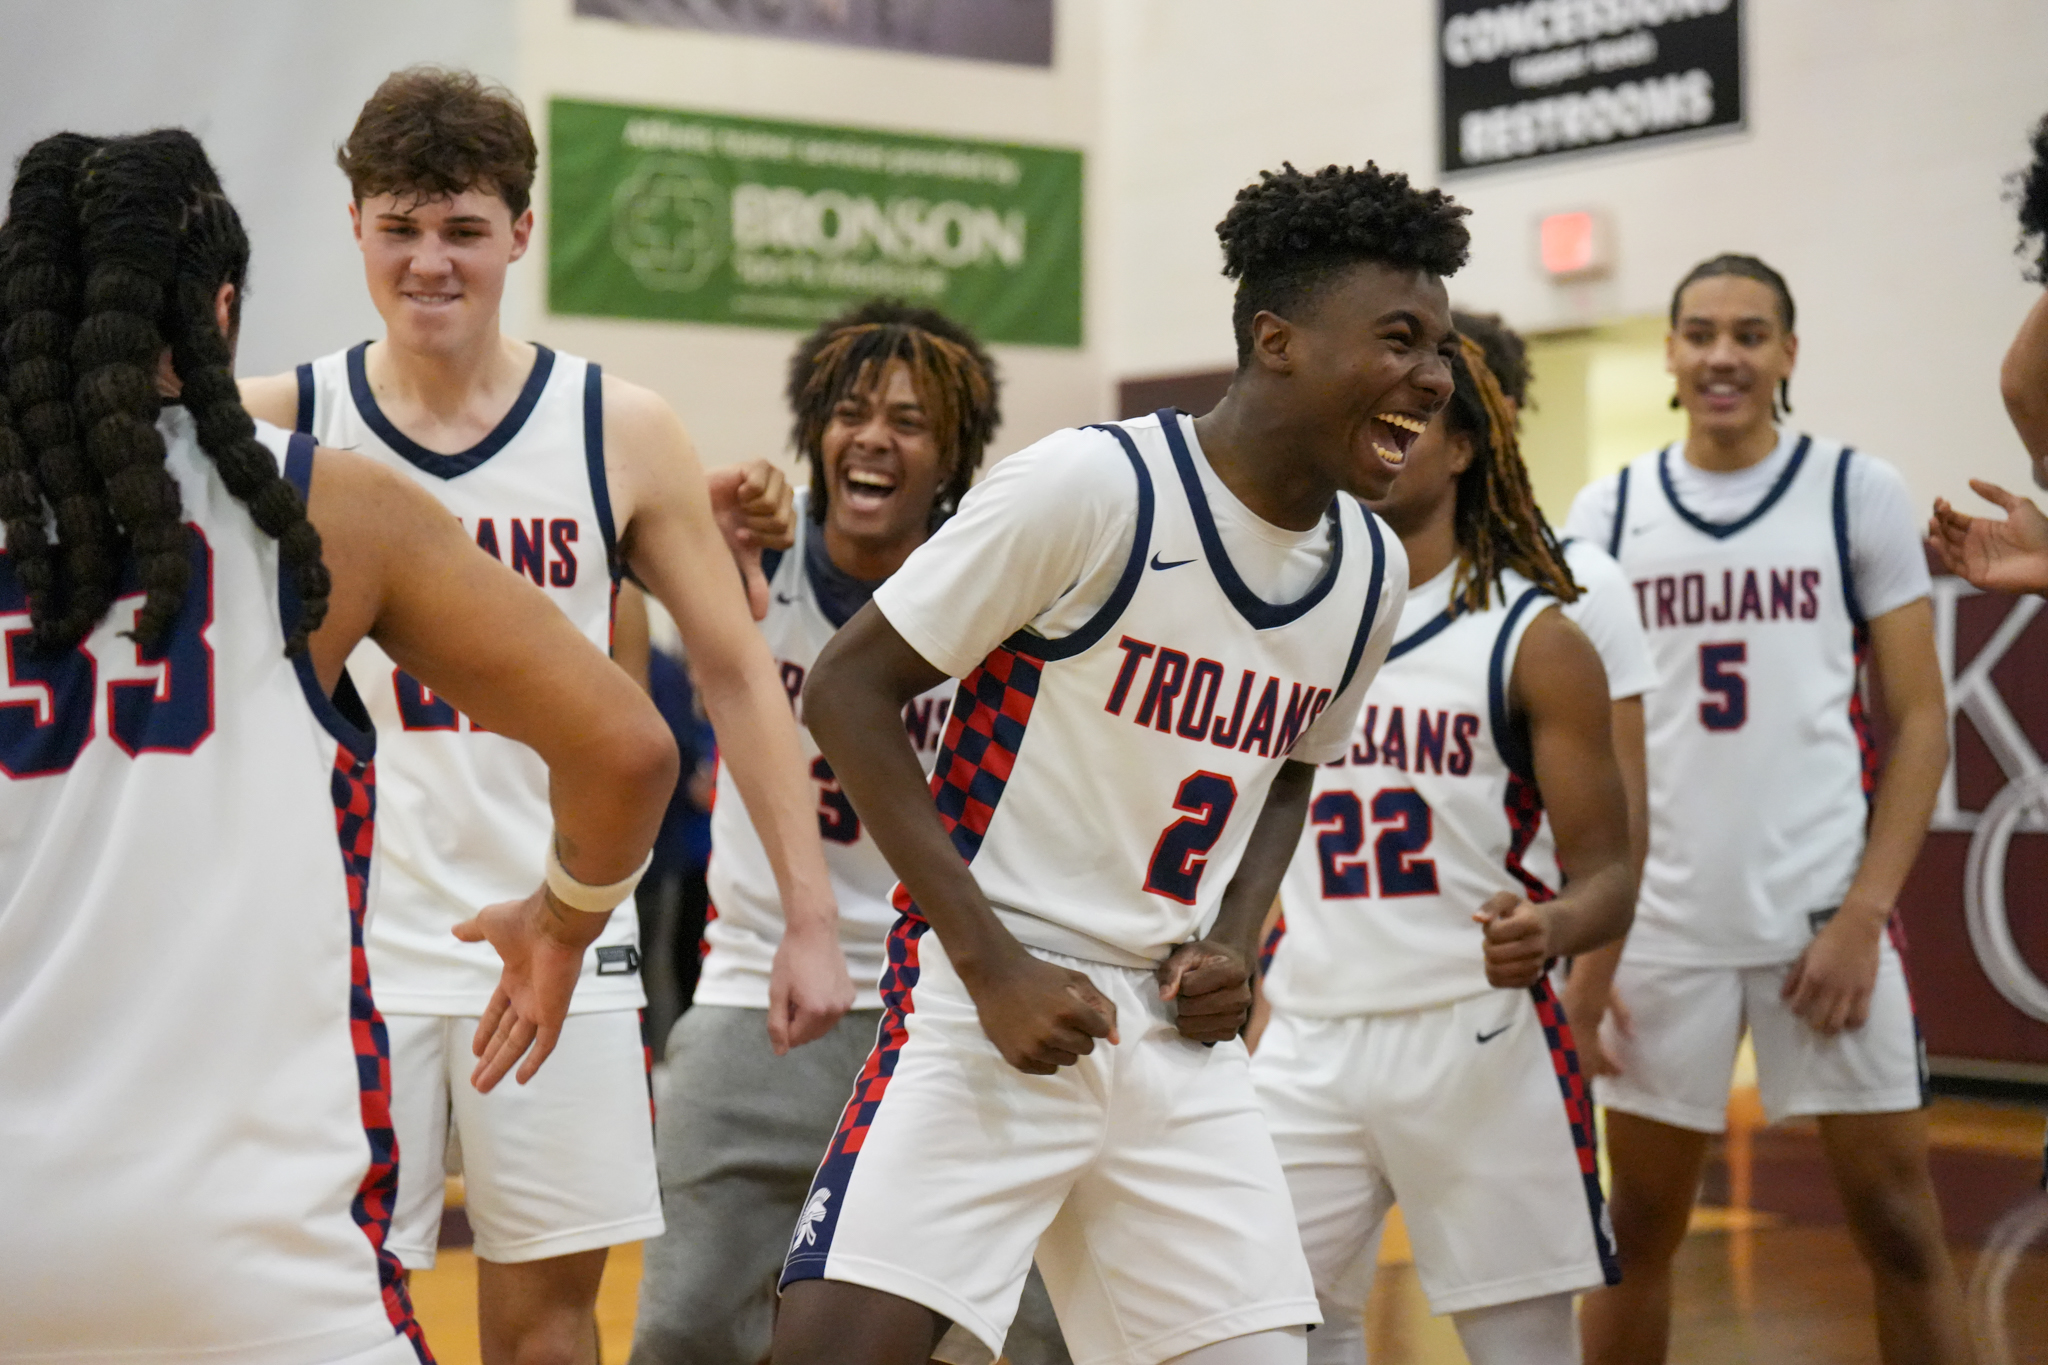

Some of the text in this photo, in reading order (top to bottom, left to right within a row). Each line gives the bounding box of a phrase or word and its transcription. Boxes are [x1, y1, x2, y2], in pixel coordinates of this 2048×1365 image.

[732, 184, 1026, 267] BRONSON
[1633, 568, 1821, 631] TROJANS
[1698, 640, 1748, 735] 5
[1142, 769, 1238, 906] 2
[1310, 787, 1440, 901] 22
